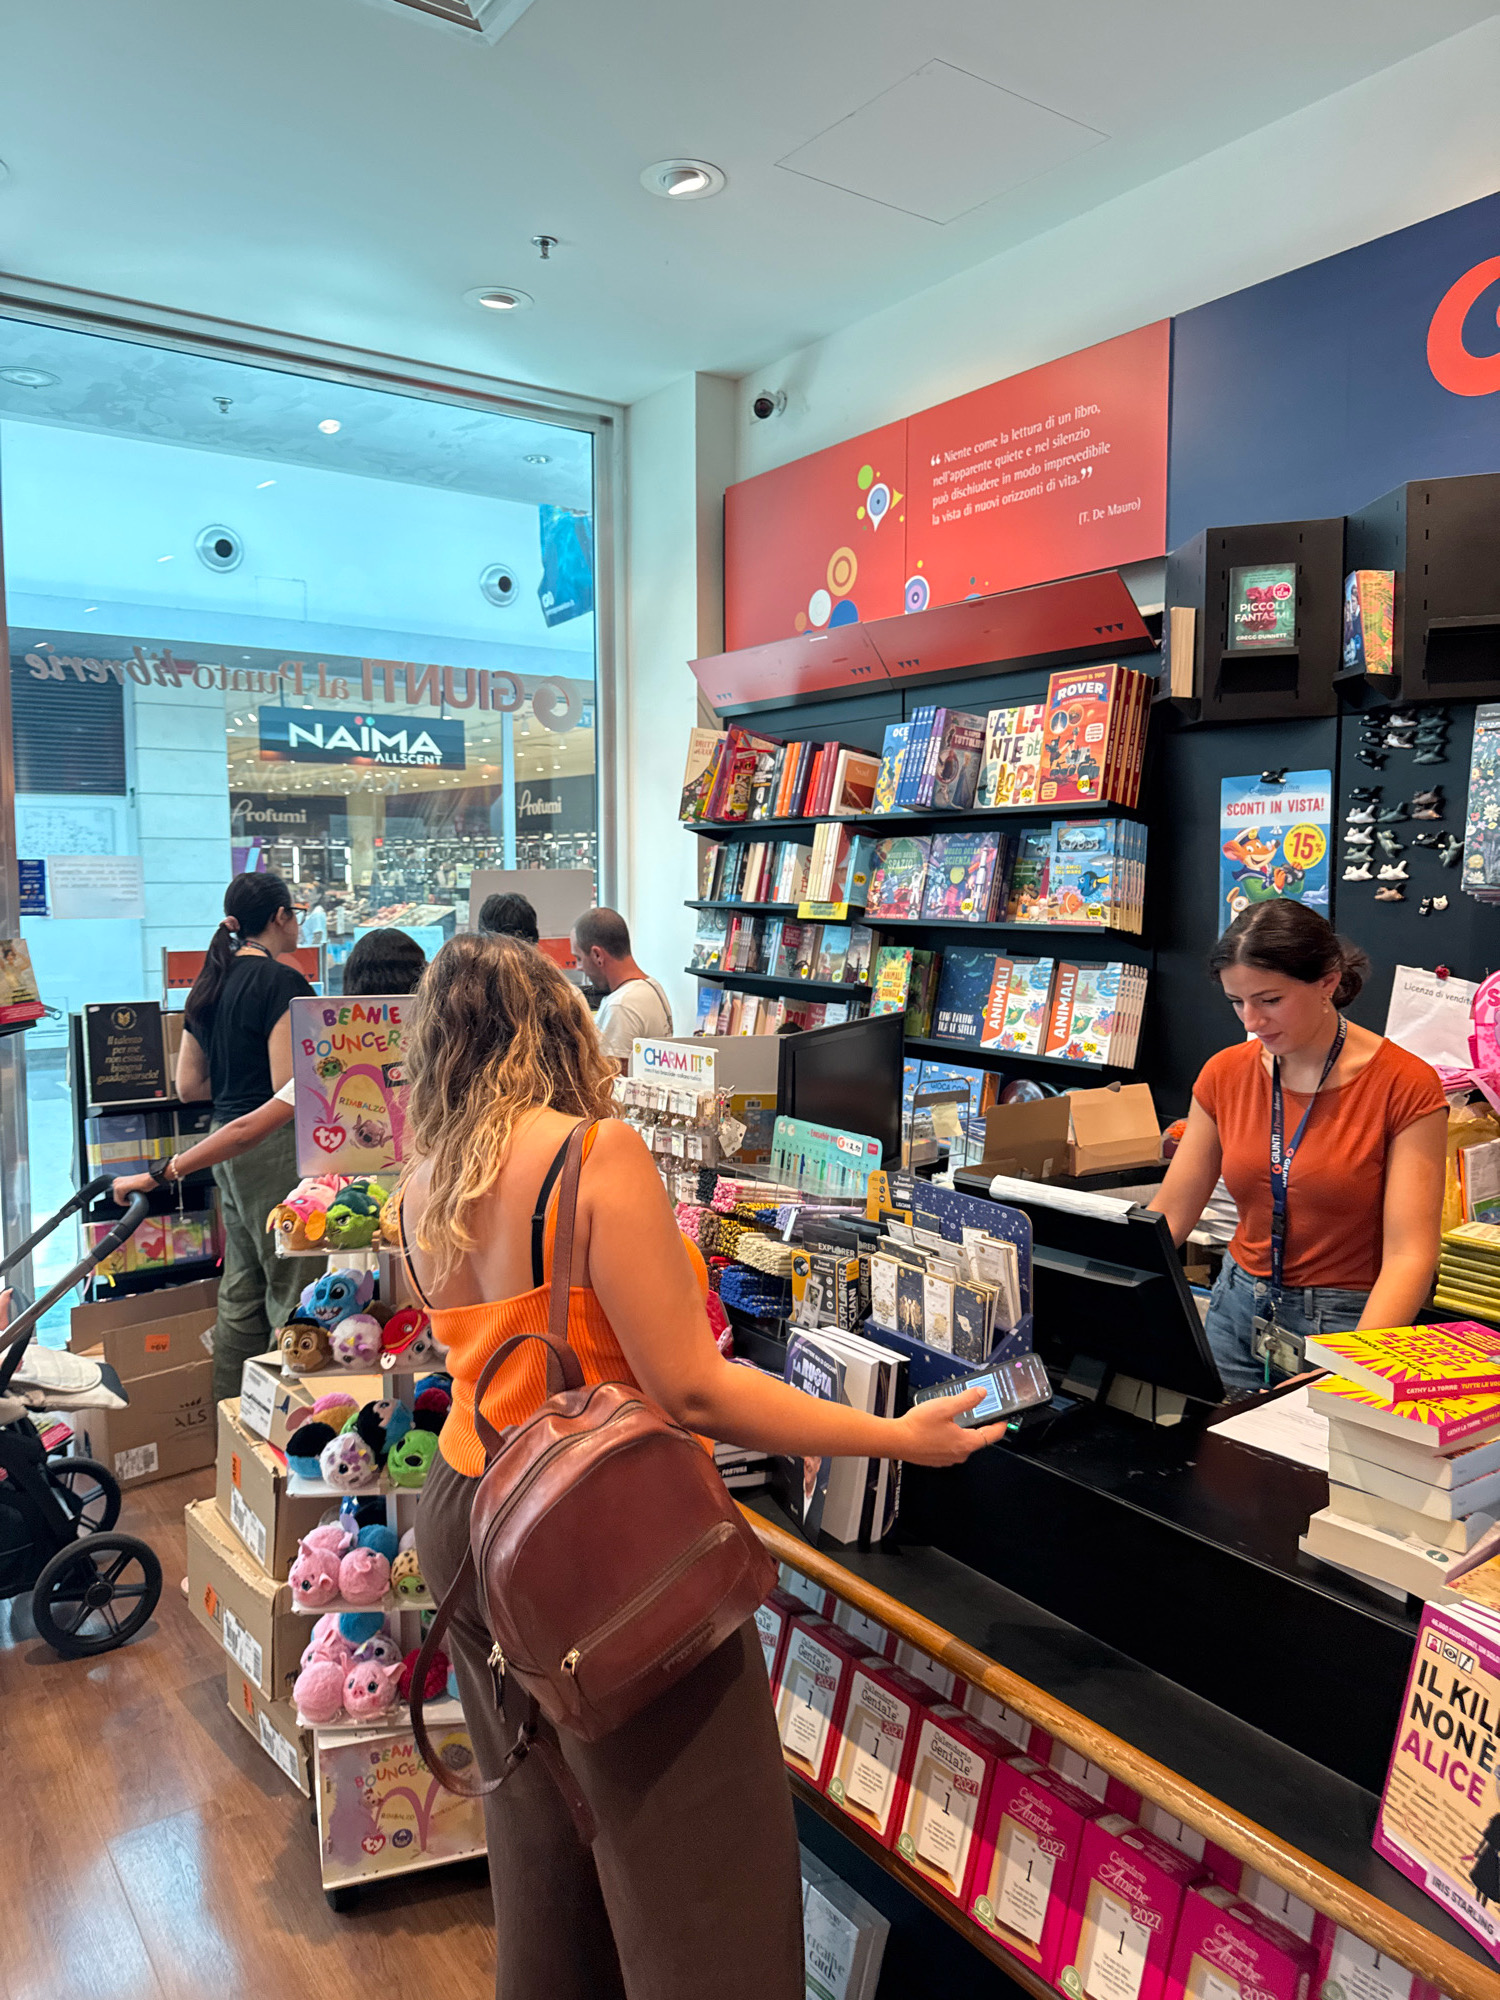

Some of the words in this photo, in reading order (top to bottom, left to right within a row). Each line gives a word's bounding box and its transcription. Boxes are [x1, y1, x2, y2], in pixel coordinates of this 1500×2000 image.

[944, 447, 972, 463] Niente
[974, 437, 998, 454] come
[1000, 432, 1009, 445] la
[1011, 422, 1043, 441] lettura
[1045, 415, 1055, 430] di
[1058, 413, 1071, 426] un
[1075, 403, 1101, 421] libro,
[932, 461, 993, 487] nell'apparente
[994, 448, 1024, 473] quiete
[1025, 446, 1032, 456] e
[1034, 438, 1050, 454] nel
[1052, 427, 1090, 448] silenzio
[932, 491, 949, 509] può
[951, 476, 1000, 501] dischiudere
[1002, 473, 1011, 485] in
[1014, 464, 1041, 481] modo
[1044, 442, 1111, 472] imprevedibile
[932, 514, 940, 526] la
[942, 508, 961, 522] vista
[963, 504, 973, 517] di
[975, 495, 1000, 514] nuovi
[1002, 482, 1043, 505] orizzonti
[1046, 478, 1056, 493] di
[1093, 508, 1105, 522] De
[1107, 497, 1141, 516] Mauro)
[1234, 611, 1290, 623] FANTASMI
[1240, 601, 1286, 613] PICCOLI
[1057, 682, 1105, 701] ROVER
[374, 752, 443, 766] ALLSCENT
[230, 798, 308, 825] Profumi
[517, 789, 563, 820] Profumi
[1226, 801, 1266, 816] SCONTI
[1270, 800, 1283, 814] IN
[1287, 797, 1325, 813] VISTA!
[887, 859, 914, 870] SPAZIO
[944, 856, 971, 866] SCIENZA
[989, 967, 1010, 1030] ANIMALI
[1404, 982, 1434, 996] Licenza
[322, 1003, 402, 1027] BEANIE
[1053, 972, 1075, 1039] ANIMALI
[644, 1047, 688, 1071] CHARM
[338, 1096, 386, 1114] RIMBALZO
[315, 1127, 343, 1149] ty
[1271, 1134, 1281, 1164] GIUNTI
[1282, 1158, 1292, 1188] GIUNTI
[1349, 1333, 1384, 1352] TORRE
[1375, 1339, 1434, 1367] TUTTE
[1380, 1332, 1438, 1359] VOLTE
[1406, 1335, 1436, 1346] LE
[1421, 1332, 1492, 1363] DONNE
[793, 1359, 802, 1375] LA
[1382, 1350, 1398, 1359] LA
[1431, 1346, 1472, 1365] CHE
[1436, 1359, 1468, 1372] LE
[802, 1358, 832, 1398] RUOTA
[1400, 1359, 1433, 1376] CATHY
[1406, 1386, 1427, 1395] CATHY
[1437, 1384, 1459, 1392] TORRE
[1461, 1382, 1481, 1390] TUTTE
[1446, 1427, 1461, 1437] CATHY
[798, 1644, 831, 1675] Geniale
[801, 1638, 832, 1663] Calendario
[816, 1675, 836, 1691] 2027
[1417, 1658, 1443, 1700] IL
[805, 1689, 813, 1711] 1
[862, 1690, 898, 1721] Geniale
[864, 1682, 898, 1710] Calendario
[883, 1721, 903, 1738] 2027
[1410, 1691, 1477, 1758] NON
[1479, 1732, 1497, 1774] È
[871, 1737, 879, 1760] 1
[930, 1740, 971, 1776] Geniale
[934, 1731, 972, 1764] Calendario
[354, 1759, 431, 1789] BOUNCER
[1400, 1729, 1487, 1808] ALICE
[954, 1776, 978, 1794] 2027
[941, 1791, 951, 1816] 1
[1009, 1799, 1055, 1836] Amiche
[363, 1837, 383, 1853] ty
[1040, 1836, 1066, 1858] 2027
[1026, 1860, 1033, 1883] 1
[1099, 1863, 1150, 1904] Amiche
[1132, 1905, 1161, 1929] 2027
[1432, 1875, 1451, 1898] IRIS
[1451, 1892, 1495, 1935] STARLING
[1117, 1930, 1125, 1955] 1
[1202, 1937, 1264, 1984] Amiche
